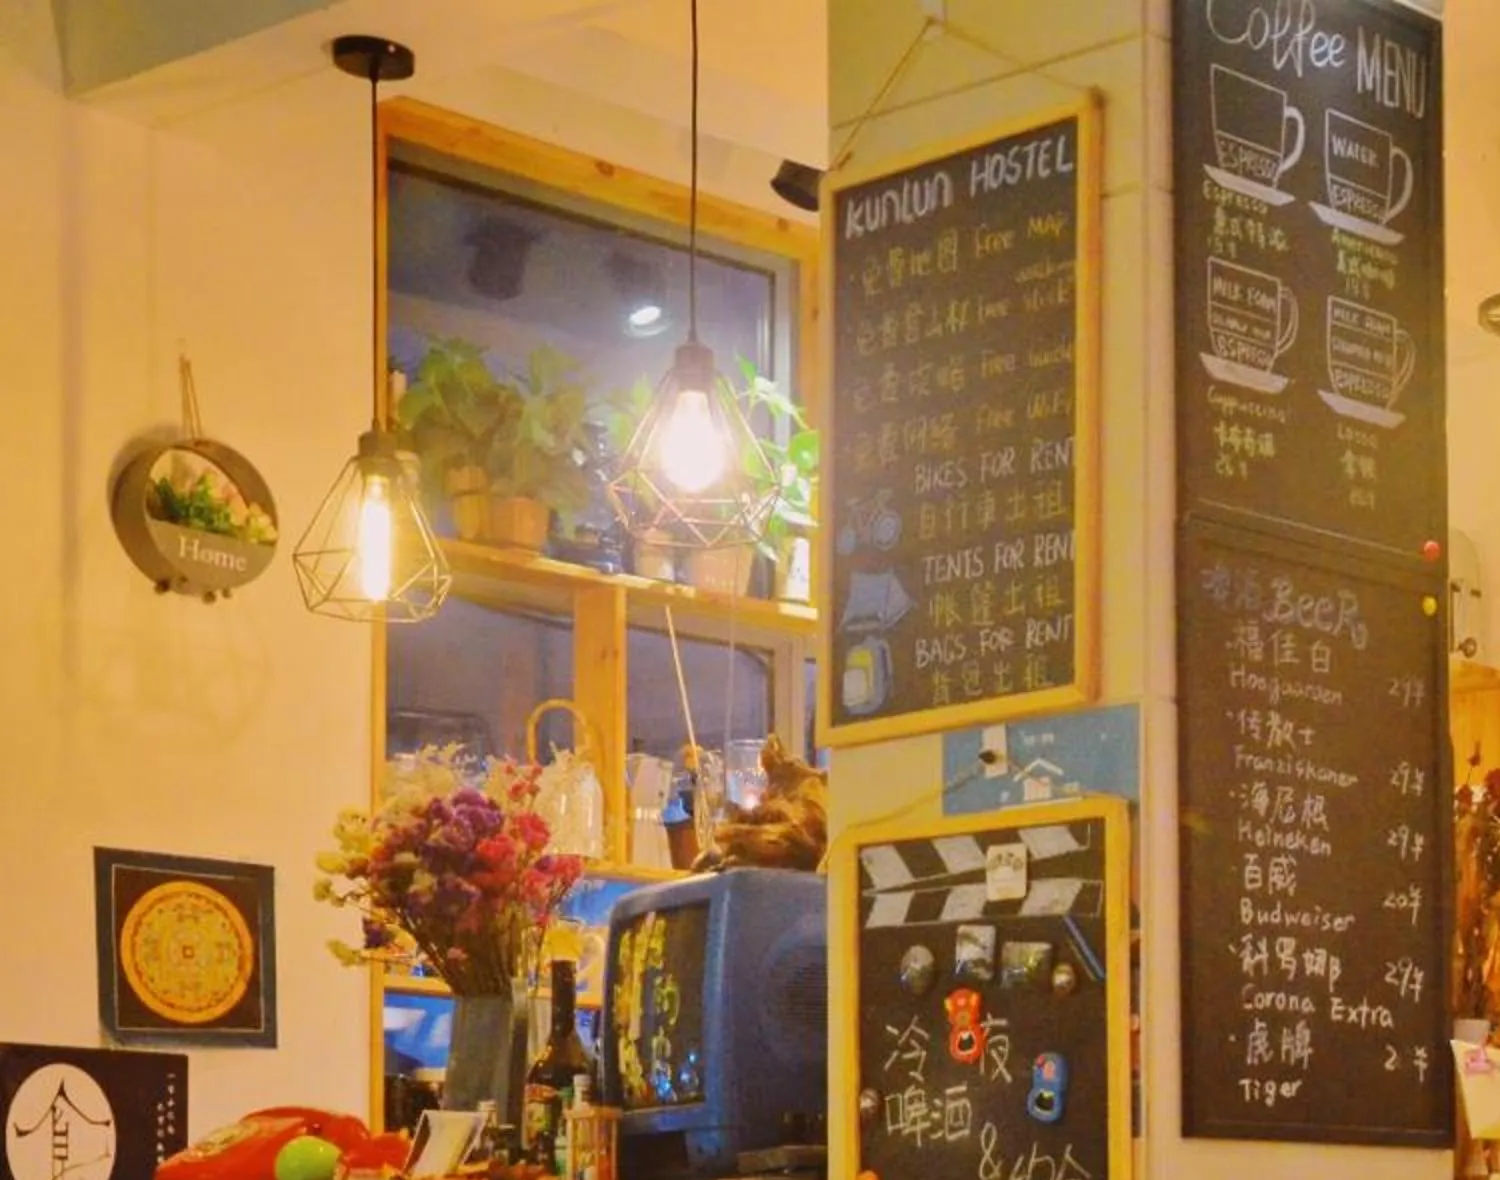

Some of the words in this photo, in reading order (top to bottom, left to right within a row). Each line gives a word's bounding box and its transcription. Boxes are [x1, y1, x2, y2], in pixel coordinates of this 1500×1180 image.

[1357, 26, 1426, 119] MENU
[969, 133, 1075, 198] HOSTEL
[914, 456, 968, 495] BIKES
[979, 446, 1016, 483] FOR
[177, 534, 248, 572] Home
[922, 544, 985, 586] TENTS
[994, 537, 1026, 575] FOR
[914, 632, 967, 669] BAGS
[979, 626, 1015, 657] FOR
[1025, 613, 1074, 650] RENT
[1243, 853, 1297, 897] 百威
[1240, 895, 1357, 932] Budweiser
[1240, 981, 1316, 1016] Corona
[1329, 995, 1395, 1031] Extra
[884, 1080, 972, 1149] 啤酒
[1238, 1077, 1304, 1108] Tiger
